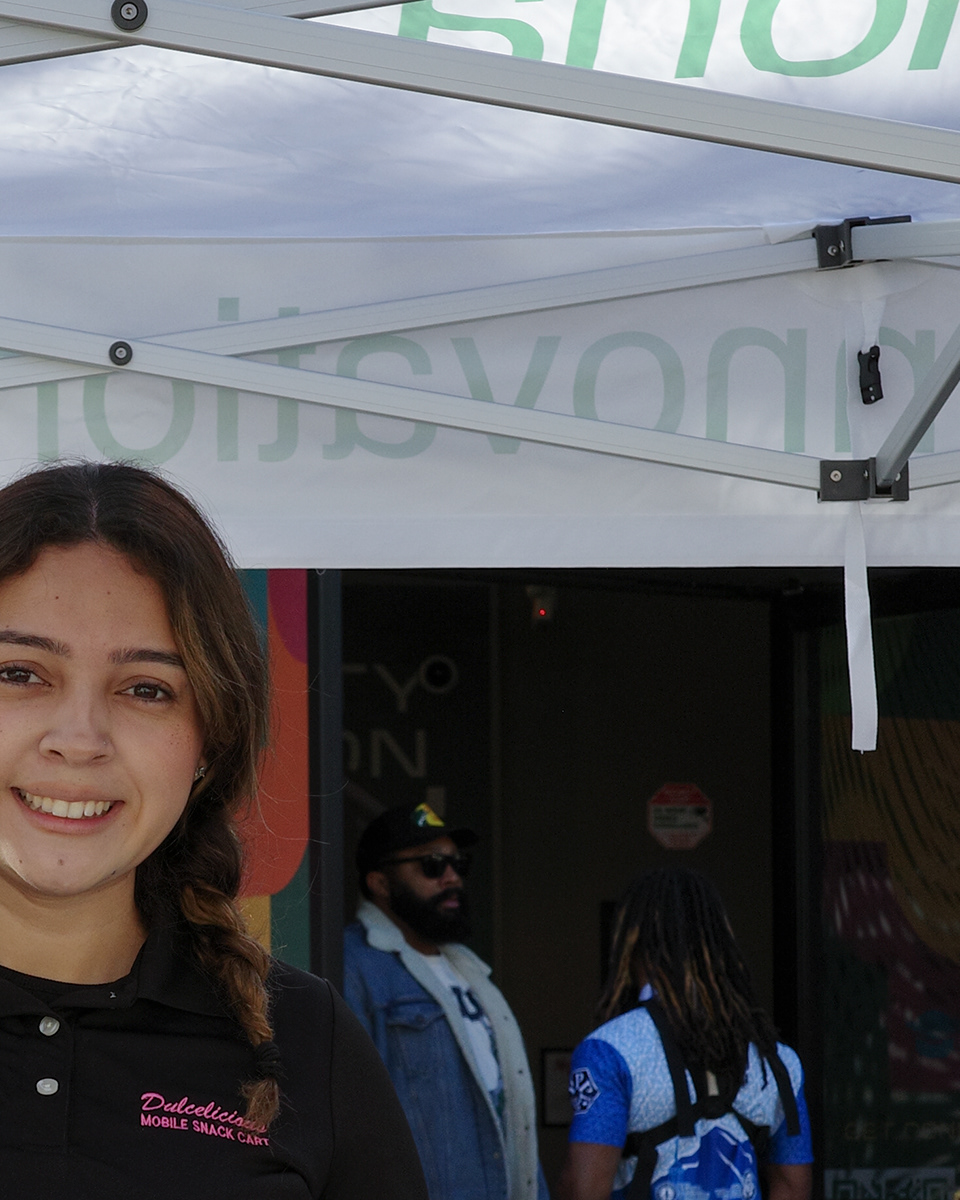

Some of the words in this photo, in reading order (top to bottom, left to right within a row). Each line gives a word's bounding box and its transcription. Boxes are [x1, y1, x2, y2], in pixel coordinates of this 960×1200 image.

[140, 1113, 189, 1130] MOBILE
[192, 1120, 236, 1141] SNACK
[237, 1131, 270, 1146] CART
